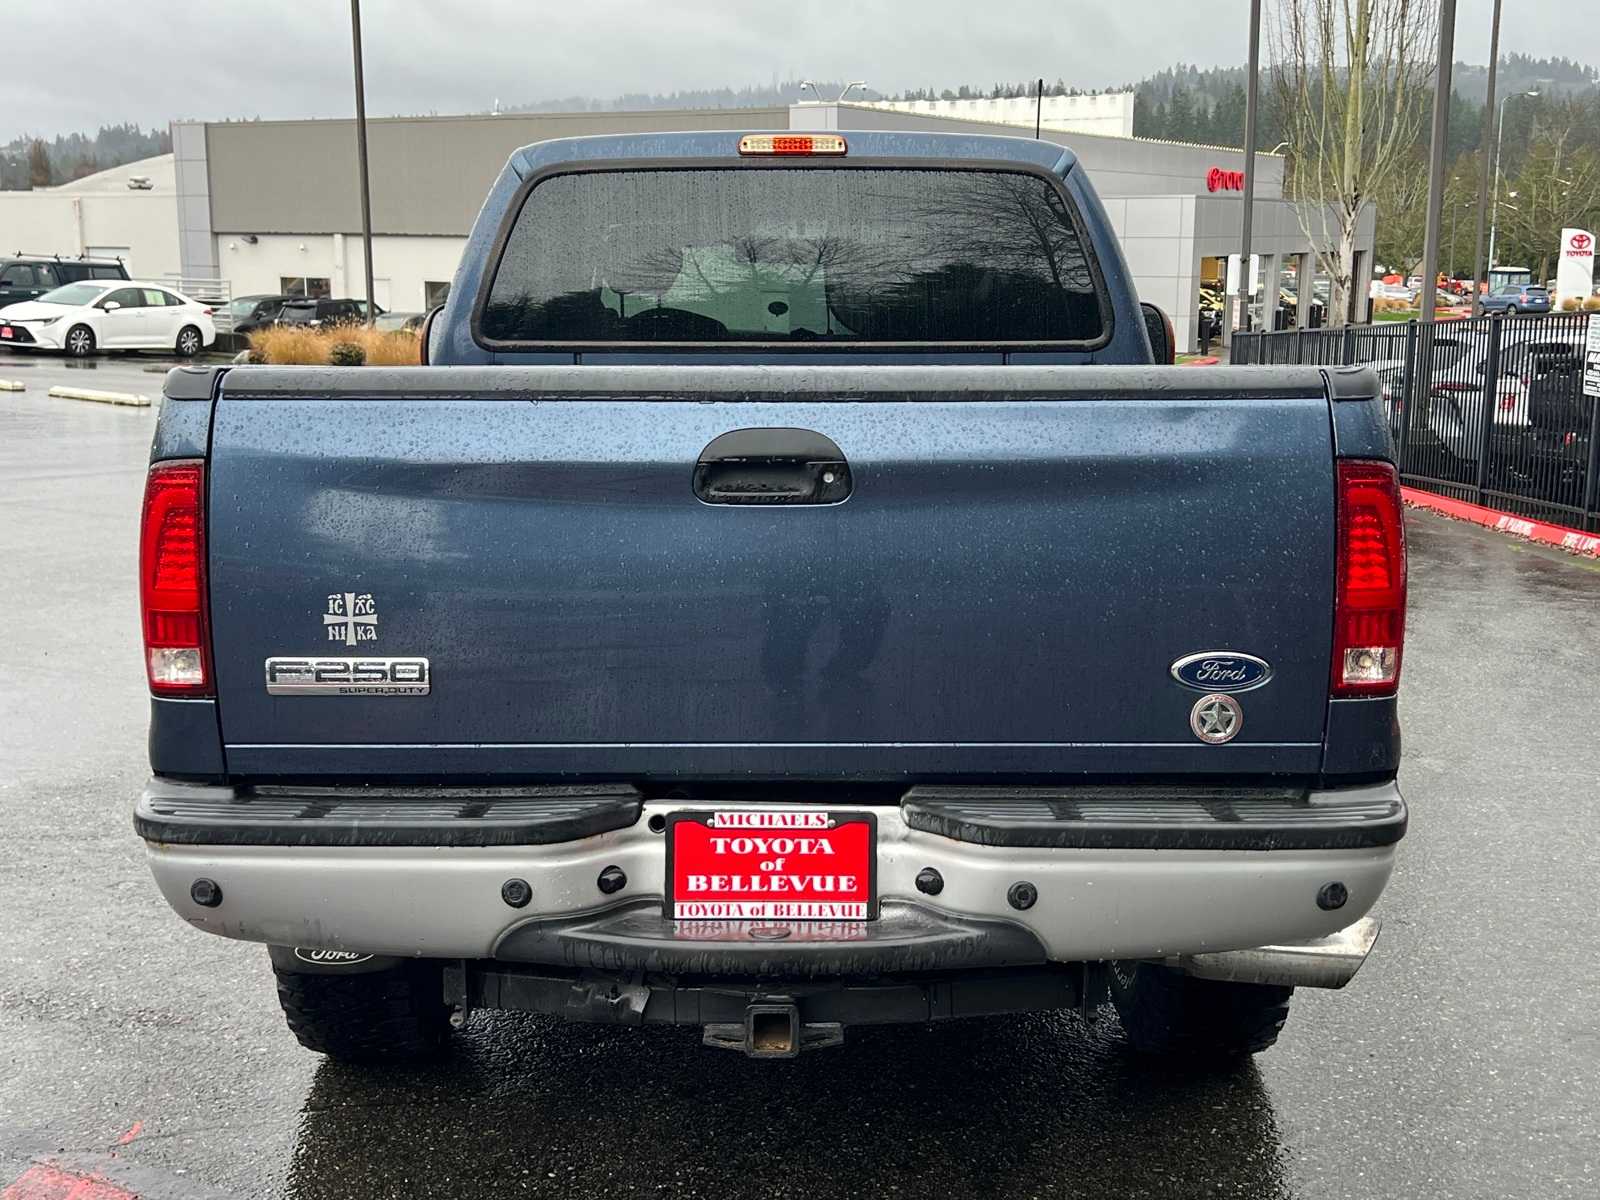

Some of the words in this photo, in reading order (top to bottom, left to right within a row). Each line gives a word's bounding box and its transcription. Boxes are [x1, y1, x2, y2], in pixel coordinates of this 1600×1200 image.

[1196, 660, 1247, 681] Ford
[339, 687, 384, 695] SUPER
[387, 687, 425, 695] DUTY
[716, 813, 827, 827] MICHAELS
[709, 837, 836, 855] TOYOTA
[759, 858, 786, 872] of
[687, 875, 858, 892] BELLEVUE
[676, 903, 744, 917] TOYOTA
[750, 903, 767, 917] of
[773, 903, 866, 917] BELLEVUE
